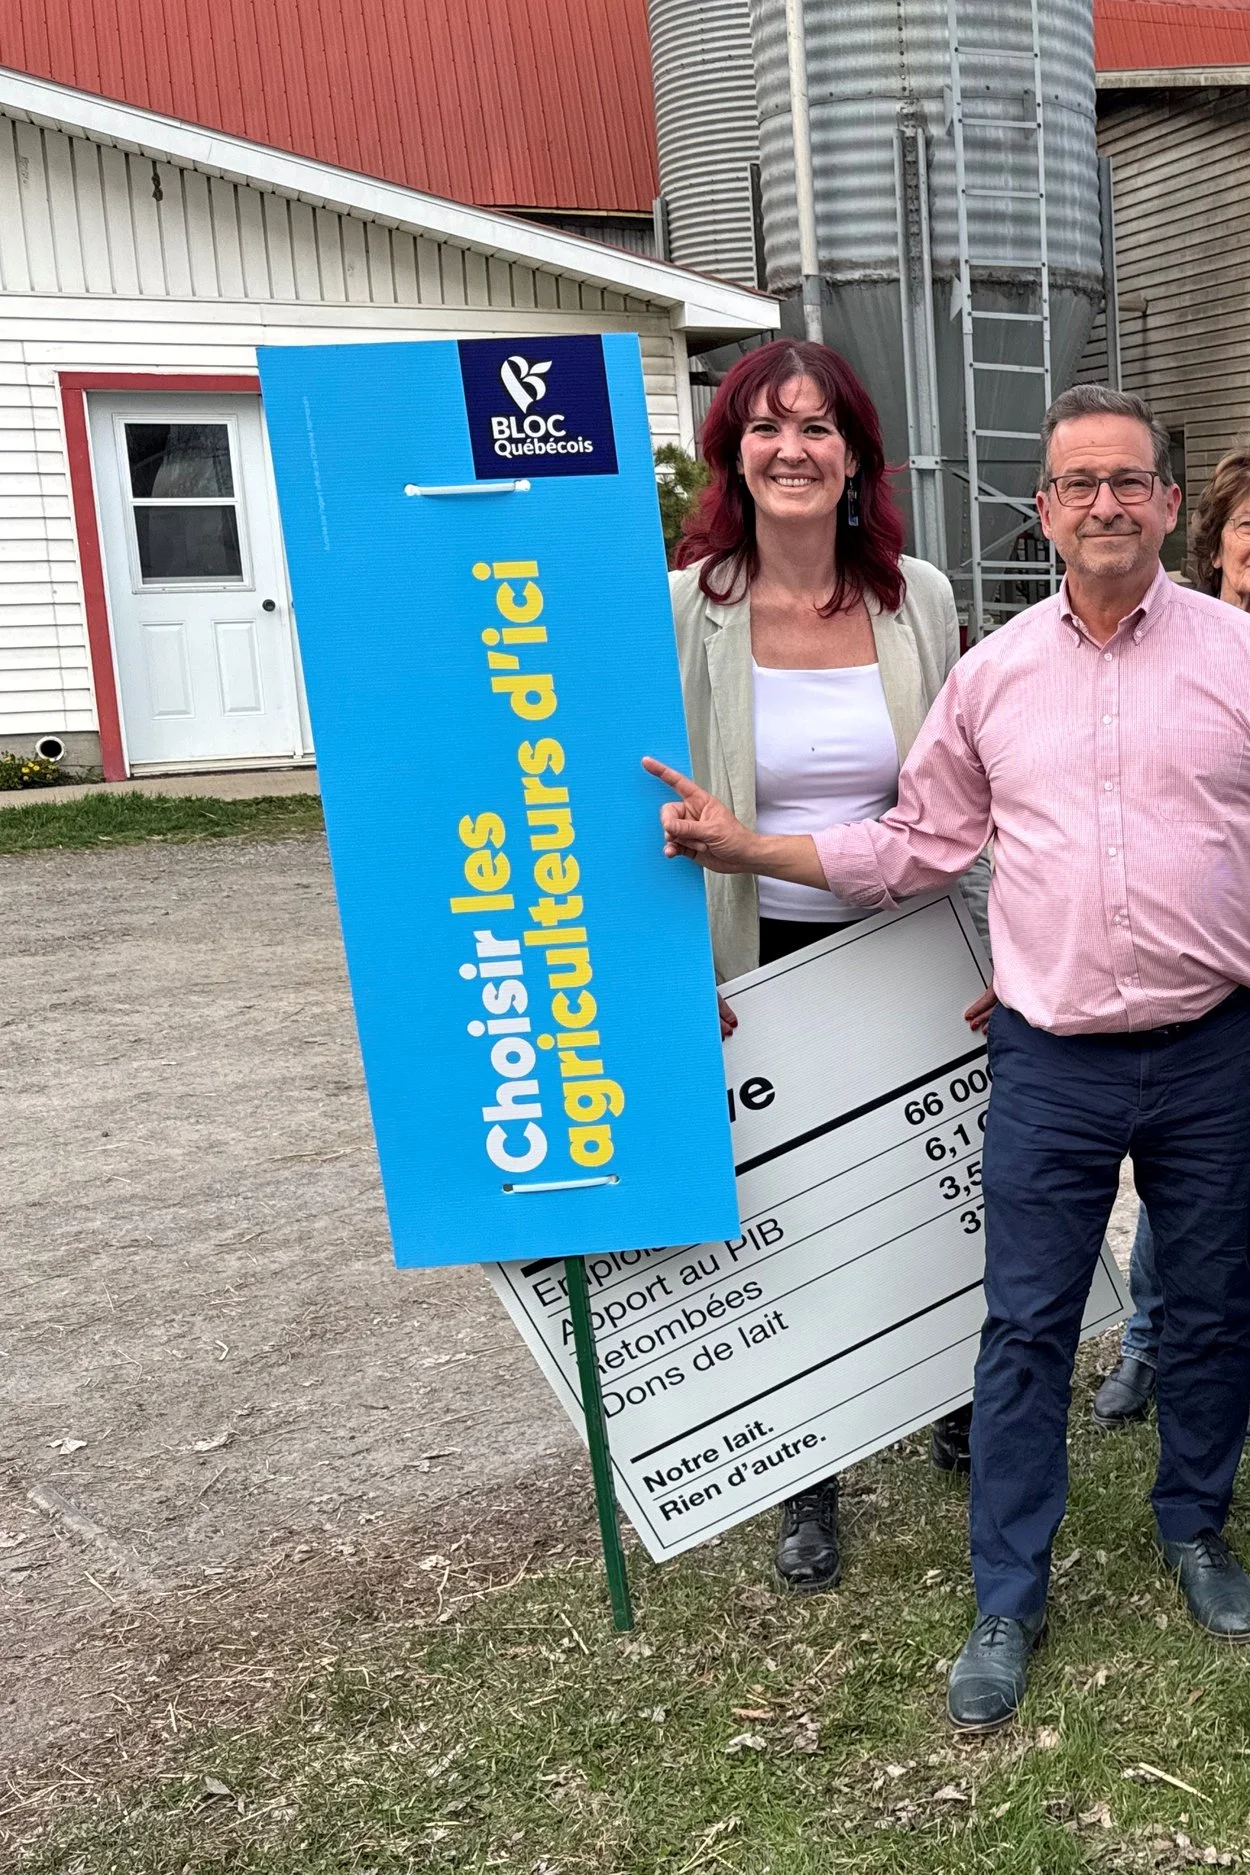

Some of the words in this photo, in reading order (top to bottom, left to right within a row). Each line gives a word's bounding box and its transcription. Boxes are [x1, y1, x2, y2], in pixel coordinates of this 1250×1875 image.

[491, 414, 566, 439] BLOC
[494, 436, 593, 458] Québécois
[472, 560, 558, 721] d'ici
[450, 811, 515, 914] les
[518, 737, 625, 1167] agriculteurs
[459, 930, 548, 1173] Choisir
[904, 1101, 944, 1126] 66
[925, 1123, 971, 1161] 6,1
[939, 1160, 983, 1200] 3,5
[679, 1253, 720, 1286] au
[724, 1217, 784, 1262] PIB
[598, 1281, 763, 1375] etombées
[601, 1366, 685, 1419] Dons
[693, 1342, 733, 1372] de
[738, 1310, 789, 1348] lait
[643, 1448, 719, 1493] Notre
[722, 1420, 774, 1452] lait.
[659, 1482, 722, 1521] Rien
